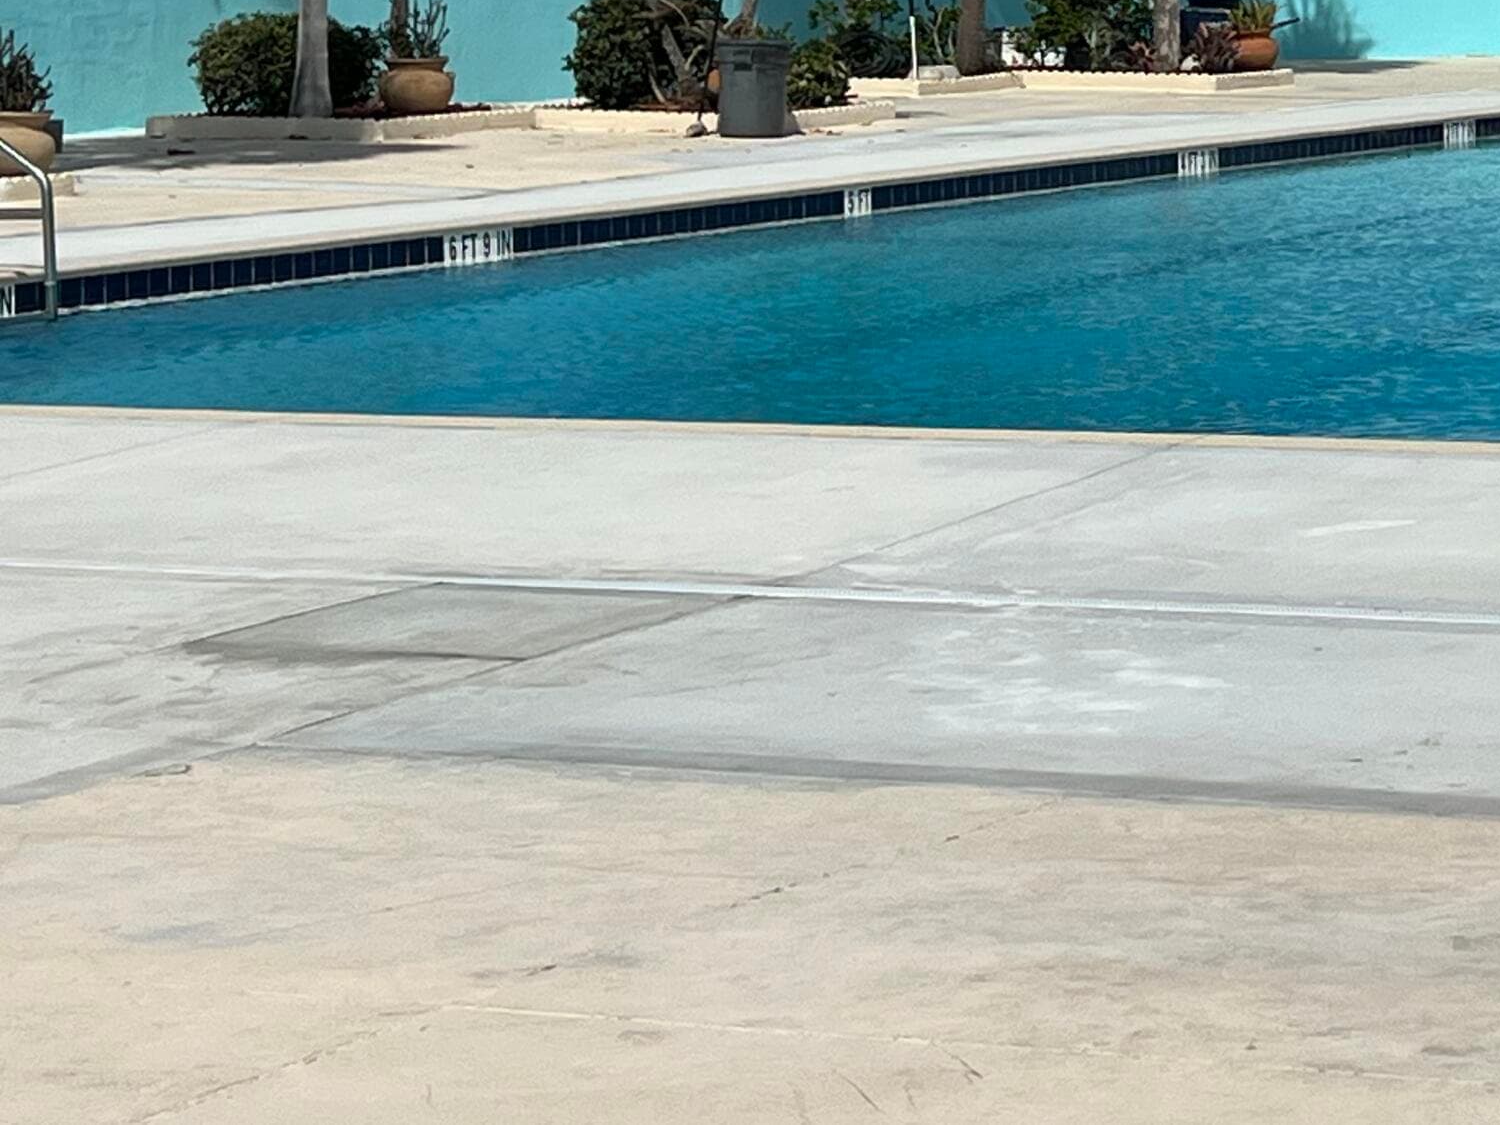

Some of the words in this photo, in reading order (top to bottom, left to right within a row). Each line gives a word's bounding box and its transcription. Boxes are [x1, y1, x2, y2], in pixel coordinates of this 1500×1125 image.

[858, 187, 870, 214] FT
[449, 236, 457, 261] 6
[462, 233, 477, 260] FT
[483, 231, 491, 258] 9
[497, 228, 511, 257] IN
